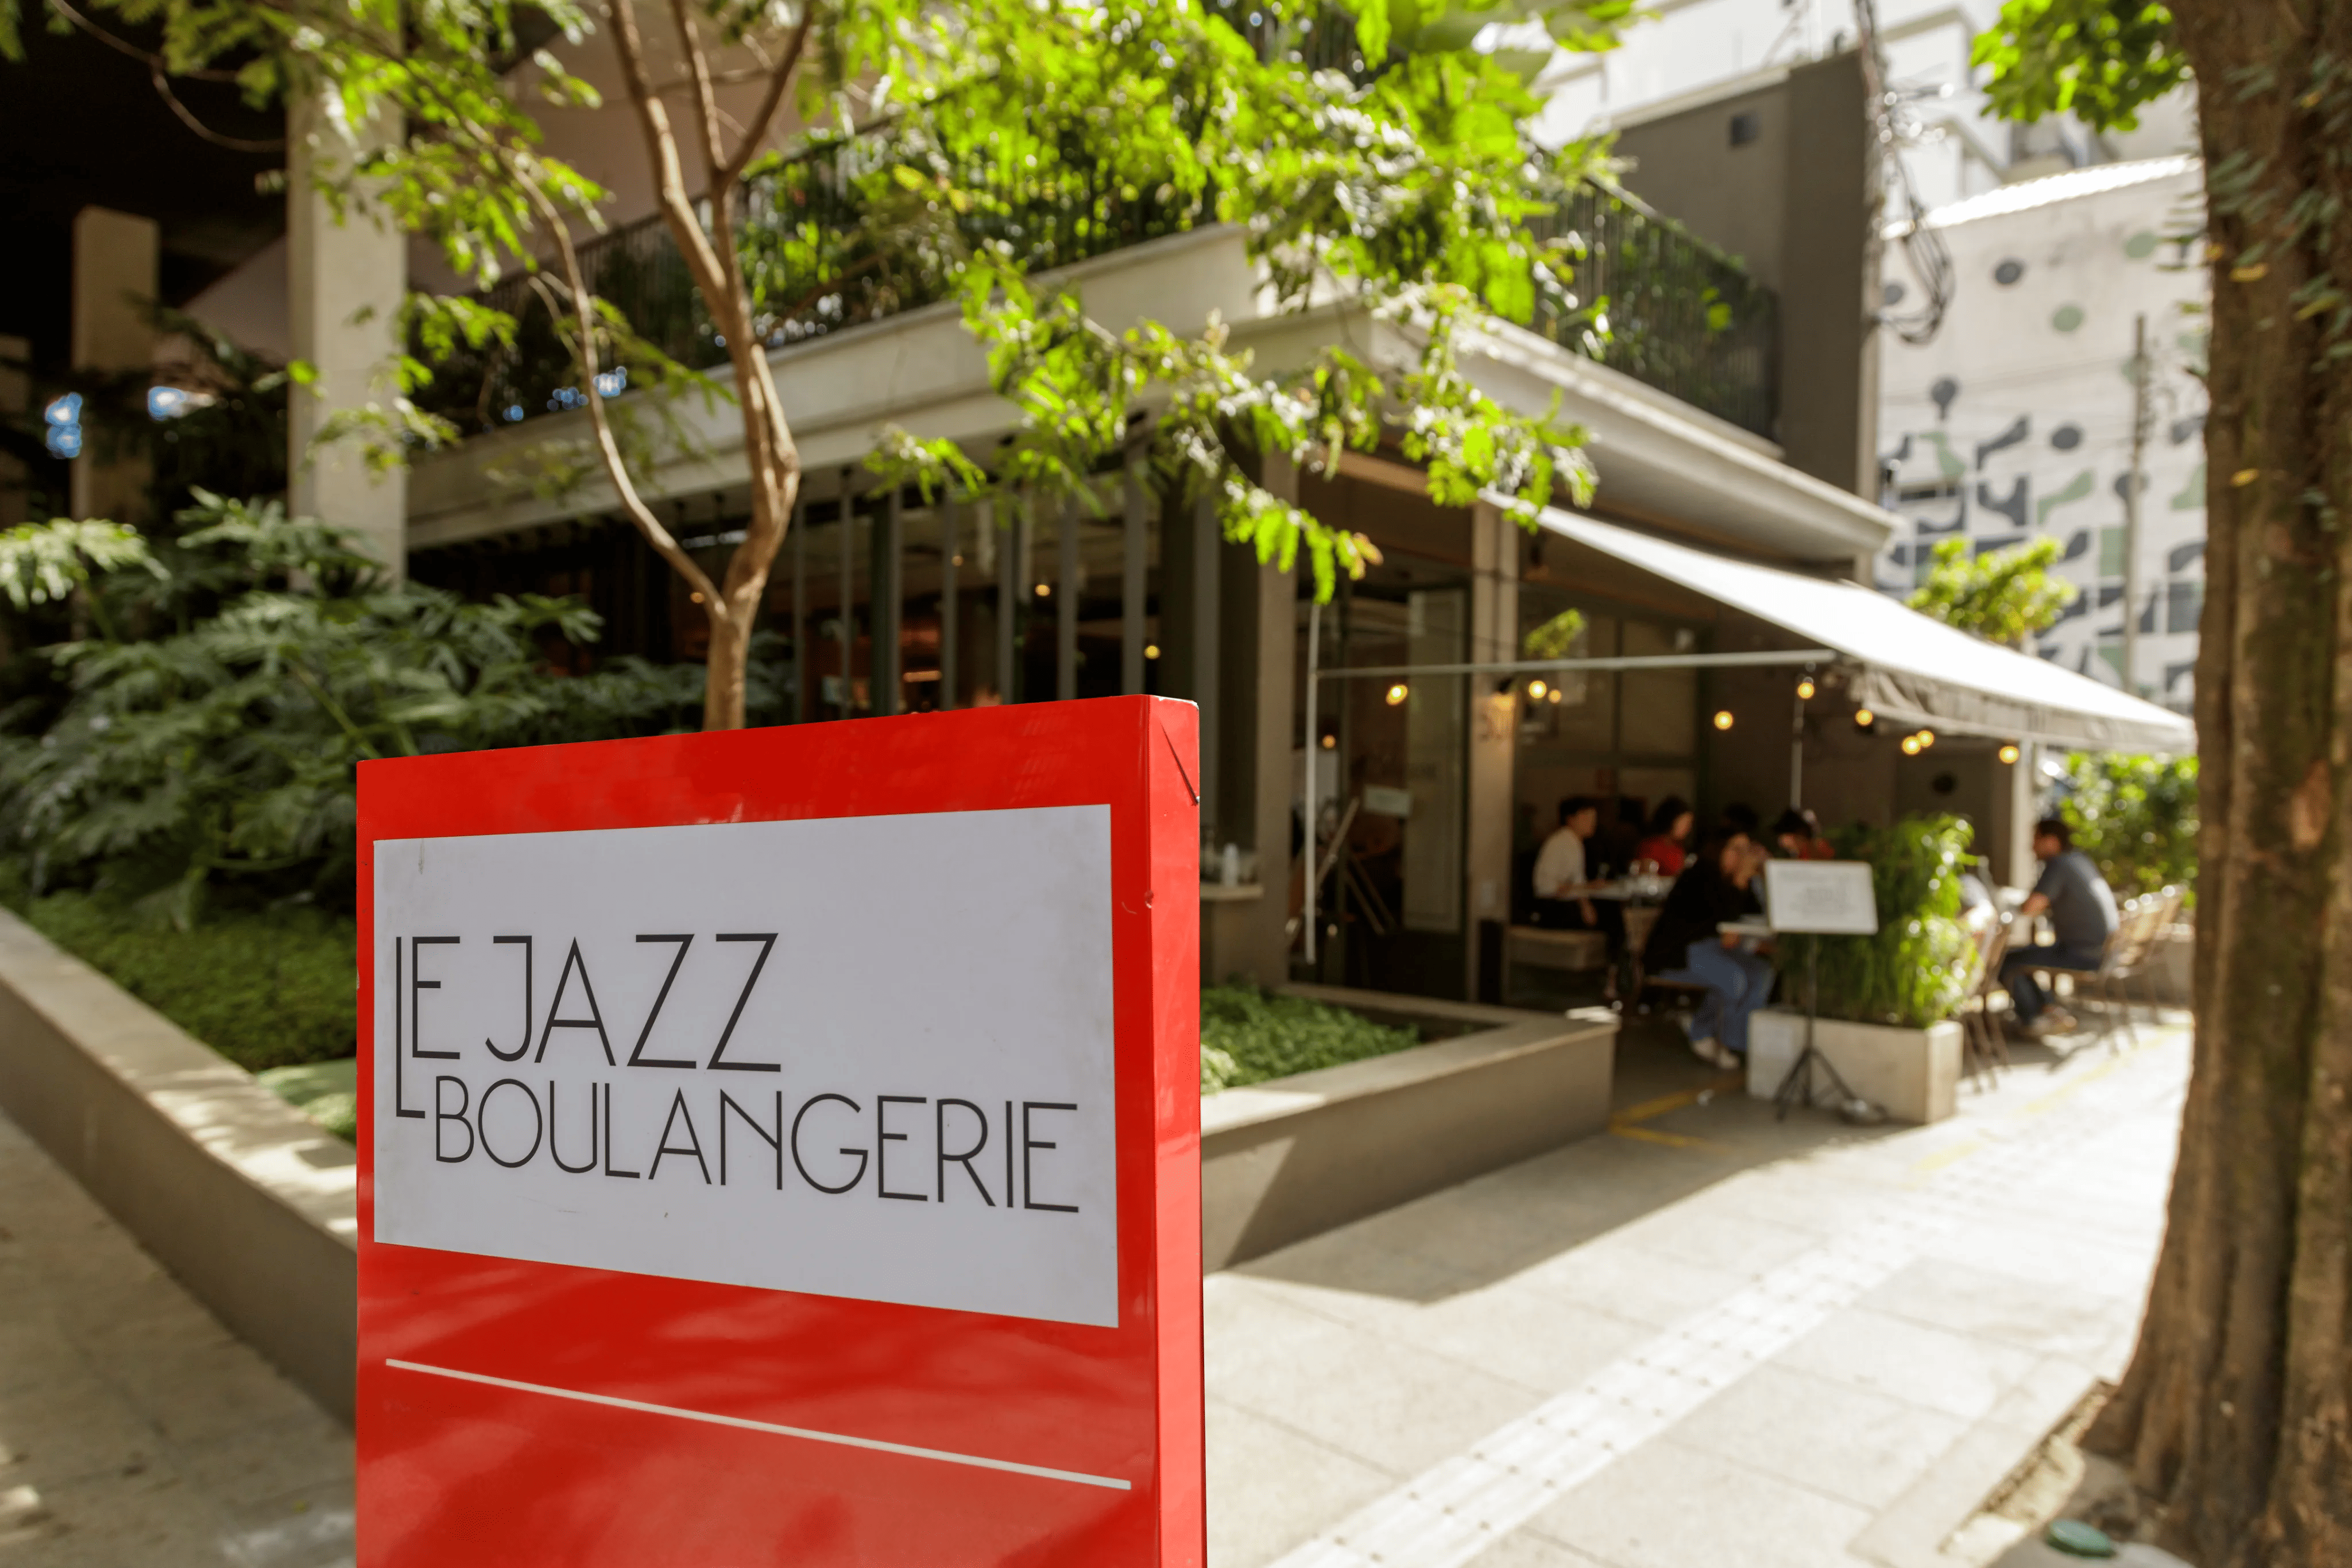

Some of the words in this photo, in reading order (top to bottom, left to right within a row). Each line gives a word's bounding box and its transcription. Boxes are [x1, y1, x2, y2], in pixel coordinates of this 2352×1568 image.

[396, 934, 461, 1119] LE
[485, 932, 782, 1073] JAZZ
[435, 1074, 1080, 1213] BOULANGERIE
